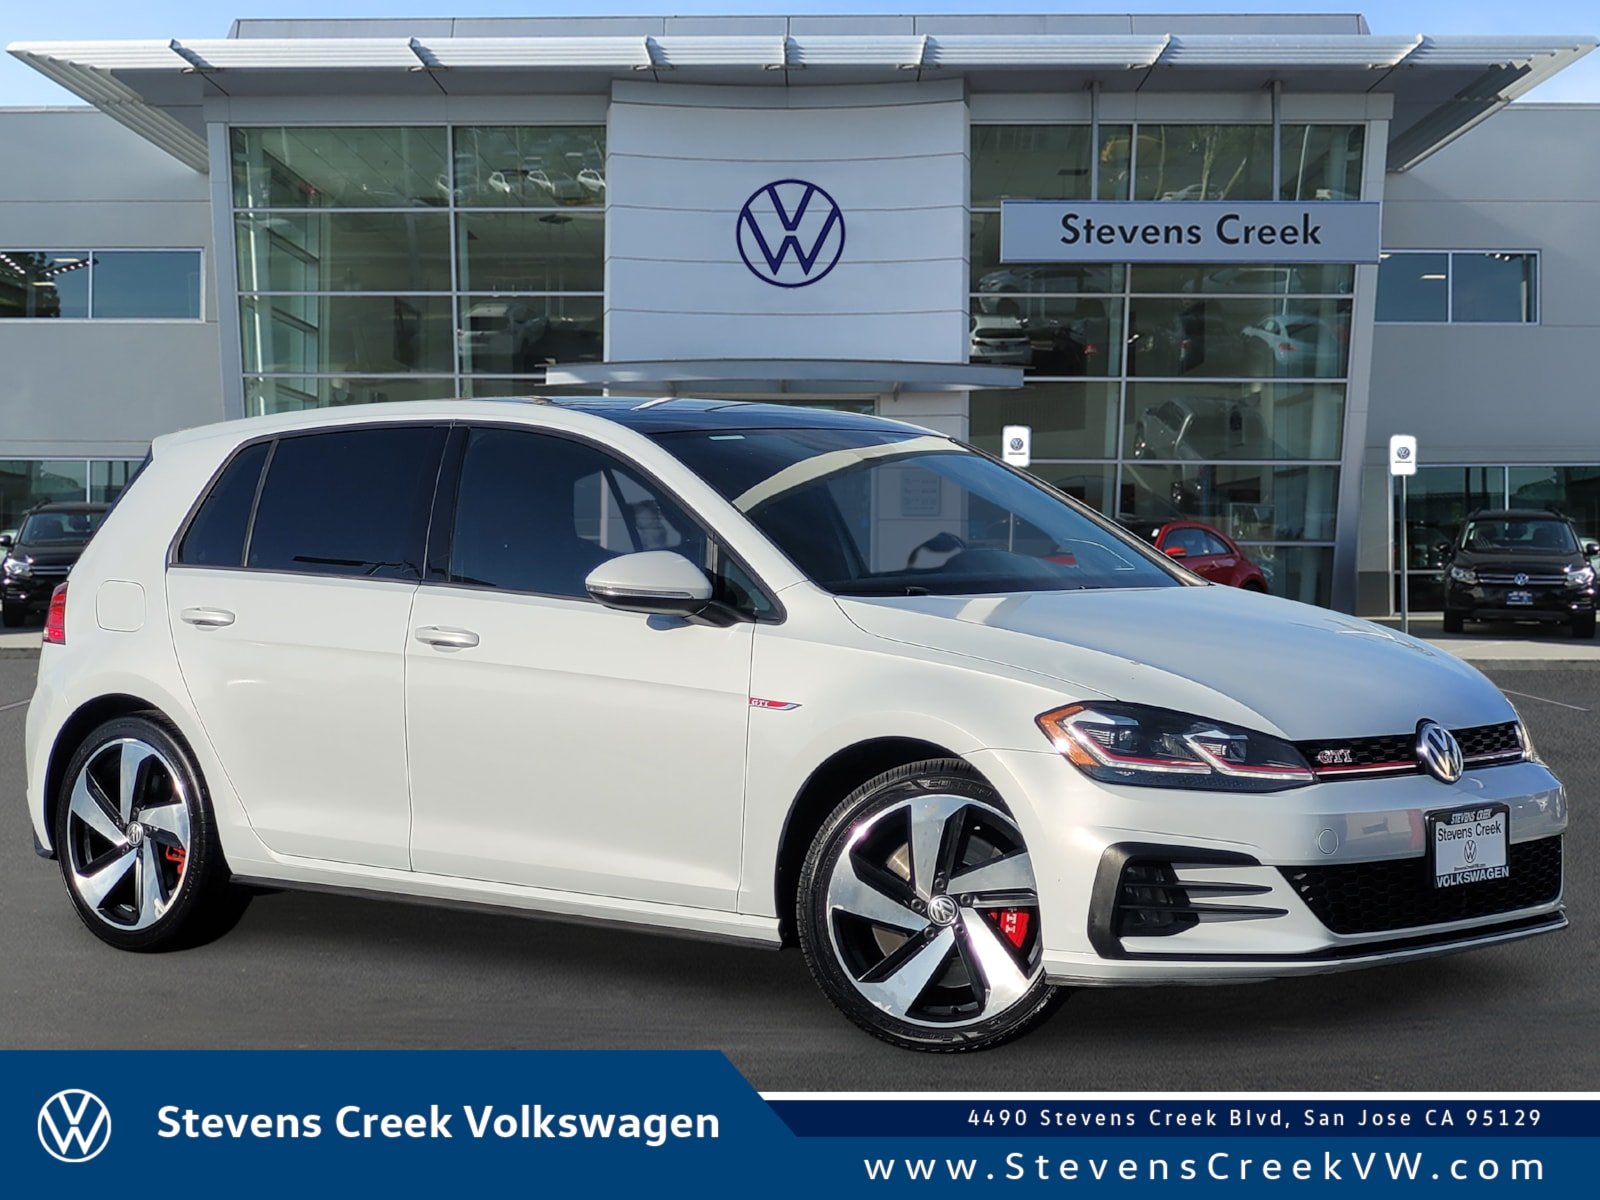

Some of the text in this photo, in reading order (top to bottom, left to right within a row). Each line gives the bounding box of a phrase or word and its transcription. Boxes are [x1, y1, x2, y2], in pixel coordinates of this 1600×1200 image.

[1060, 212, 1322, 245] Stevens Creek
[1317, 749, 1352, 764] GTI
[1437, 820, 1502, 842] Stevens Creek
[1436, 866, 1510, 888] VOLKSWAGEN
